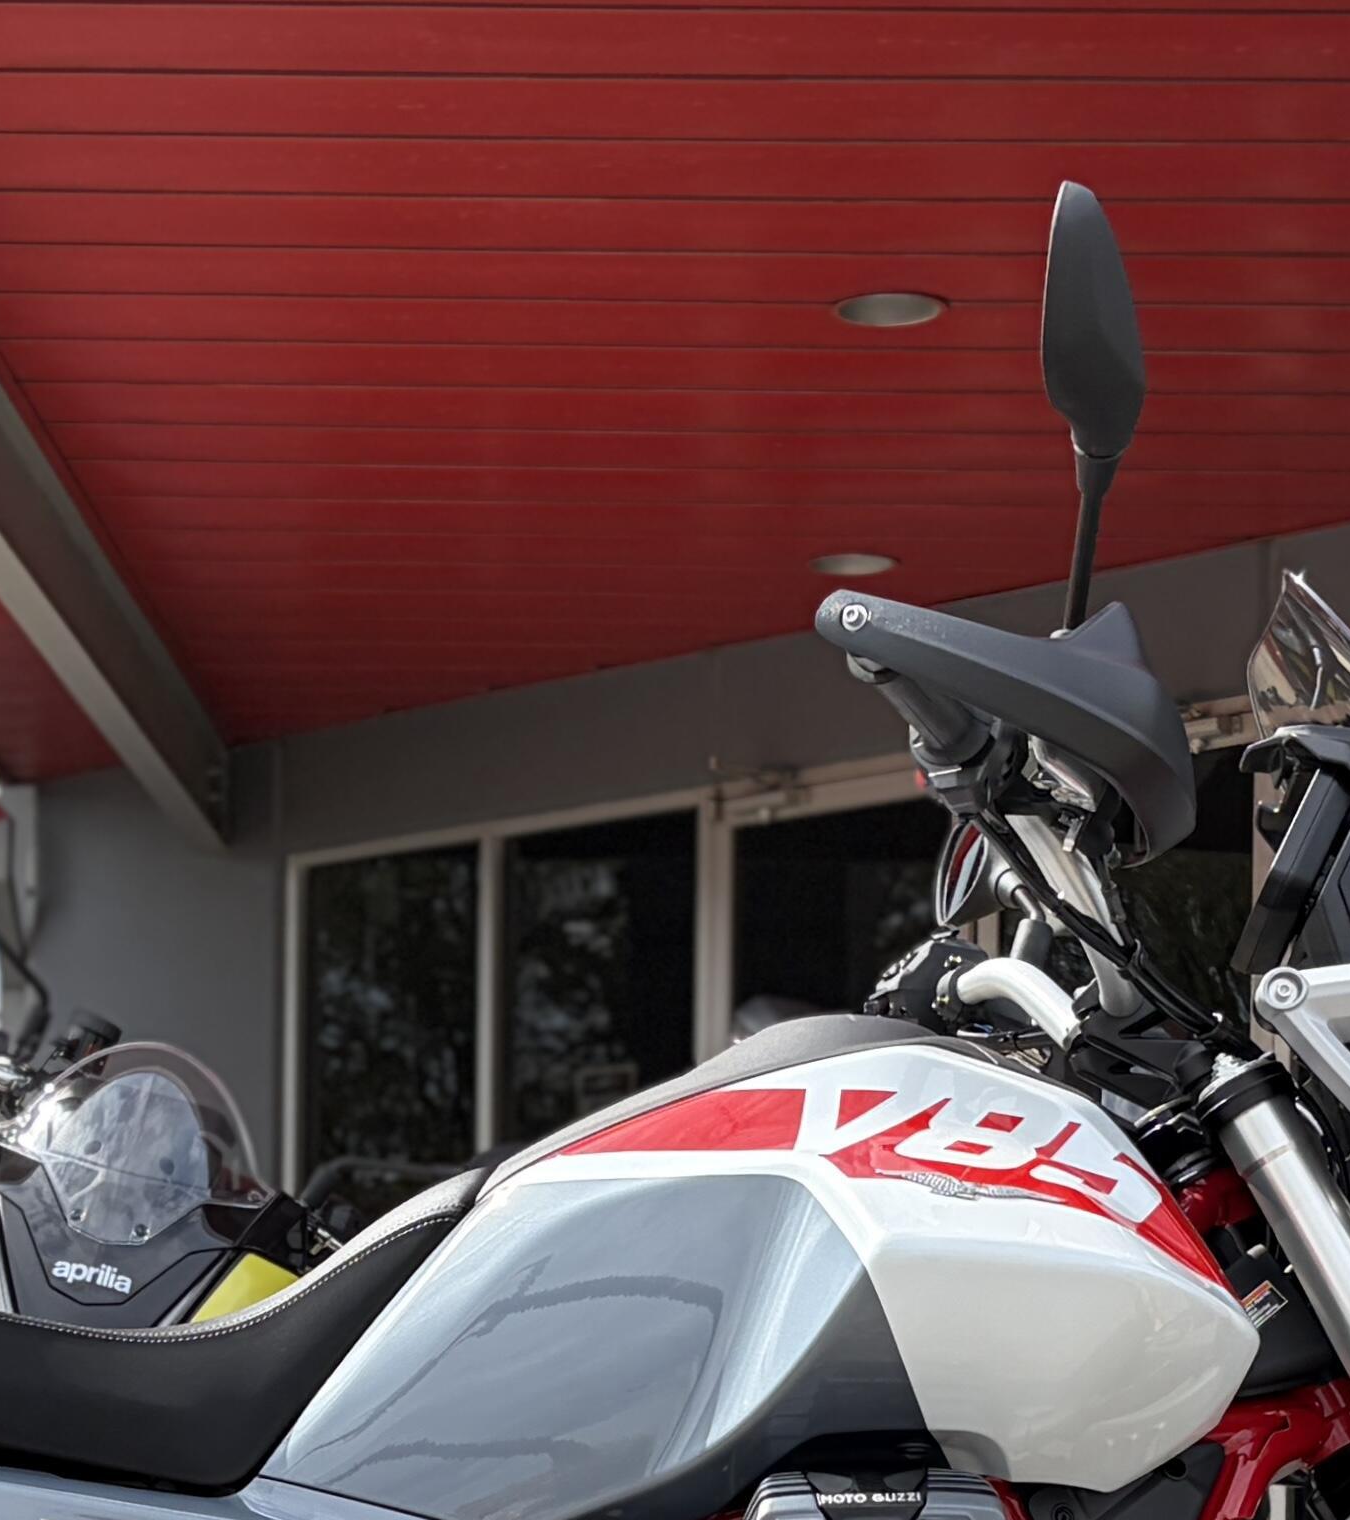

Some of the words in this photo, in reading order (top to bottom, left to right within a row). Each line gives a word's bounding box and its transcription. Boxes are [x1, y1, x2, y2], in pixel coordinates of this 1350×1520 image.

[794, 1086, 1164, 1224] V85
[51, 1260, 132, 1294] aprilia
[819, 1492, 866, 1505] MOTO
[872, 1491, 921, 1503] GUZZI
